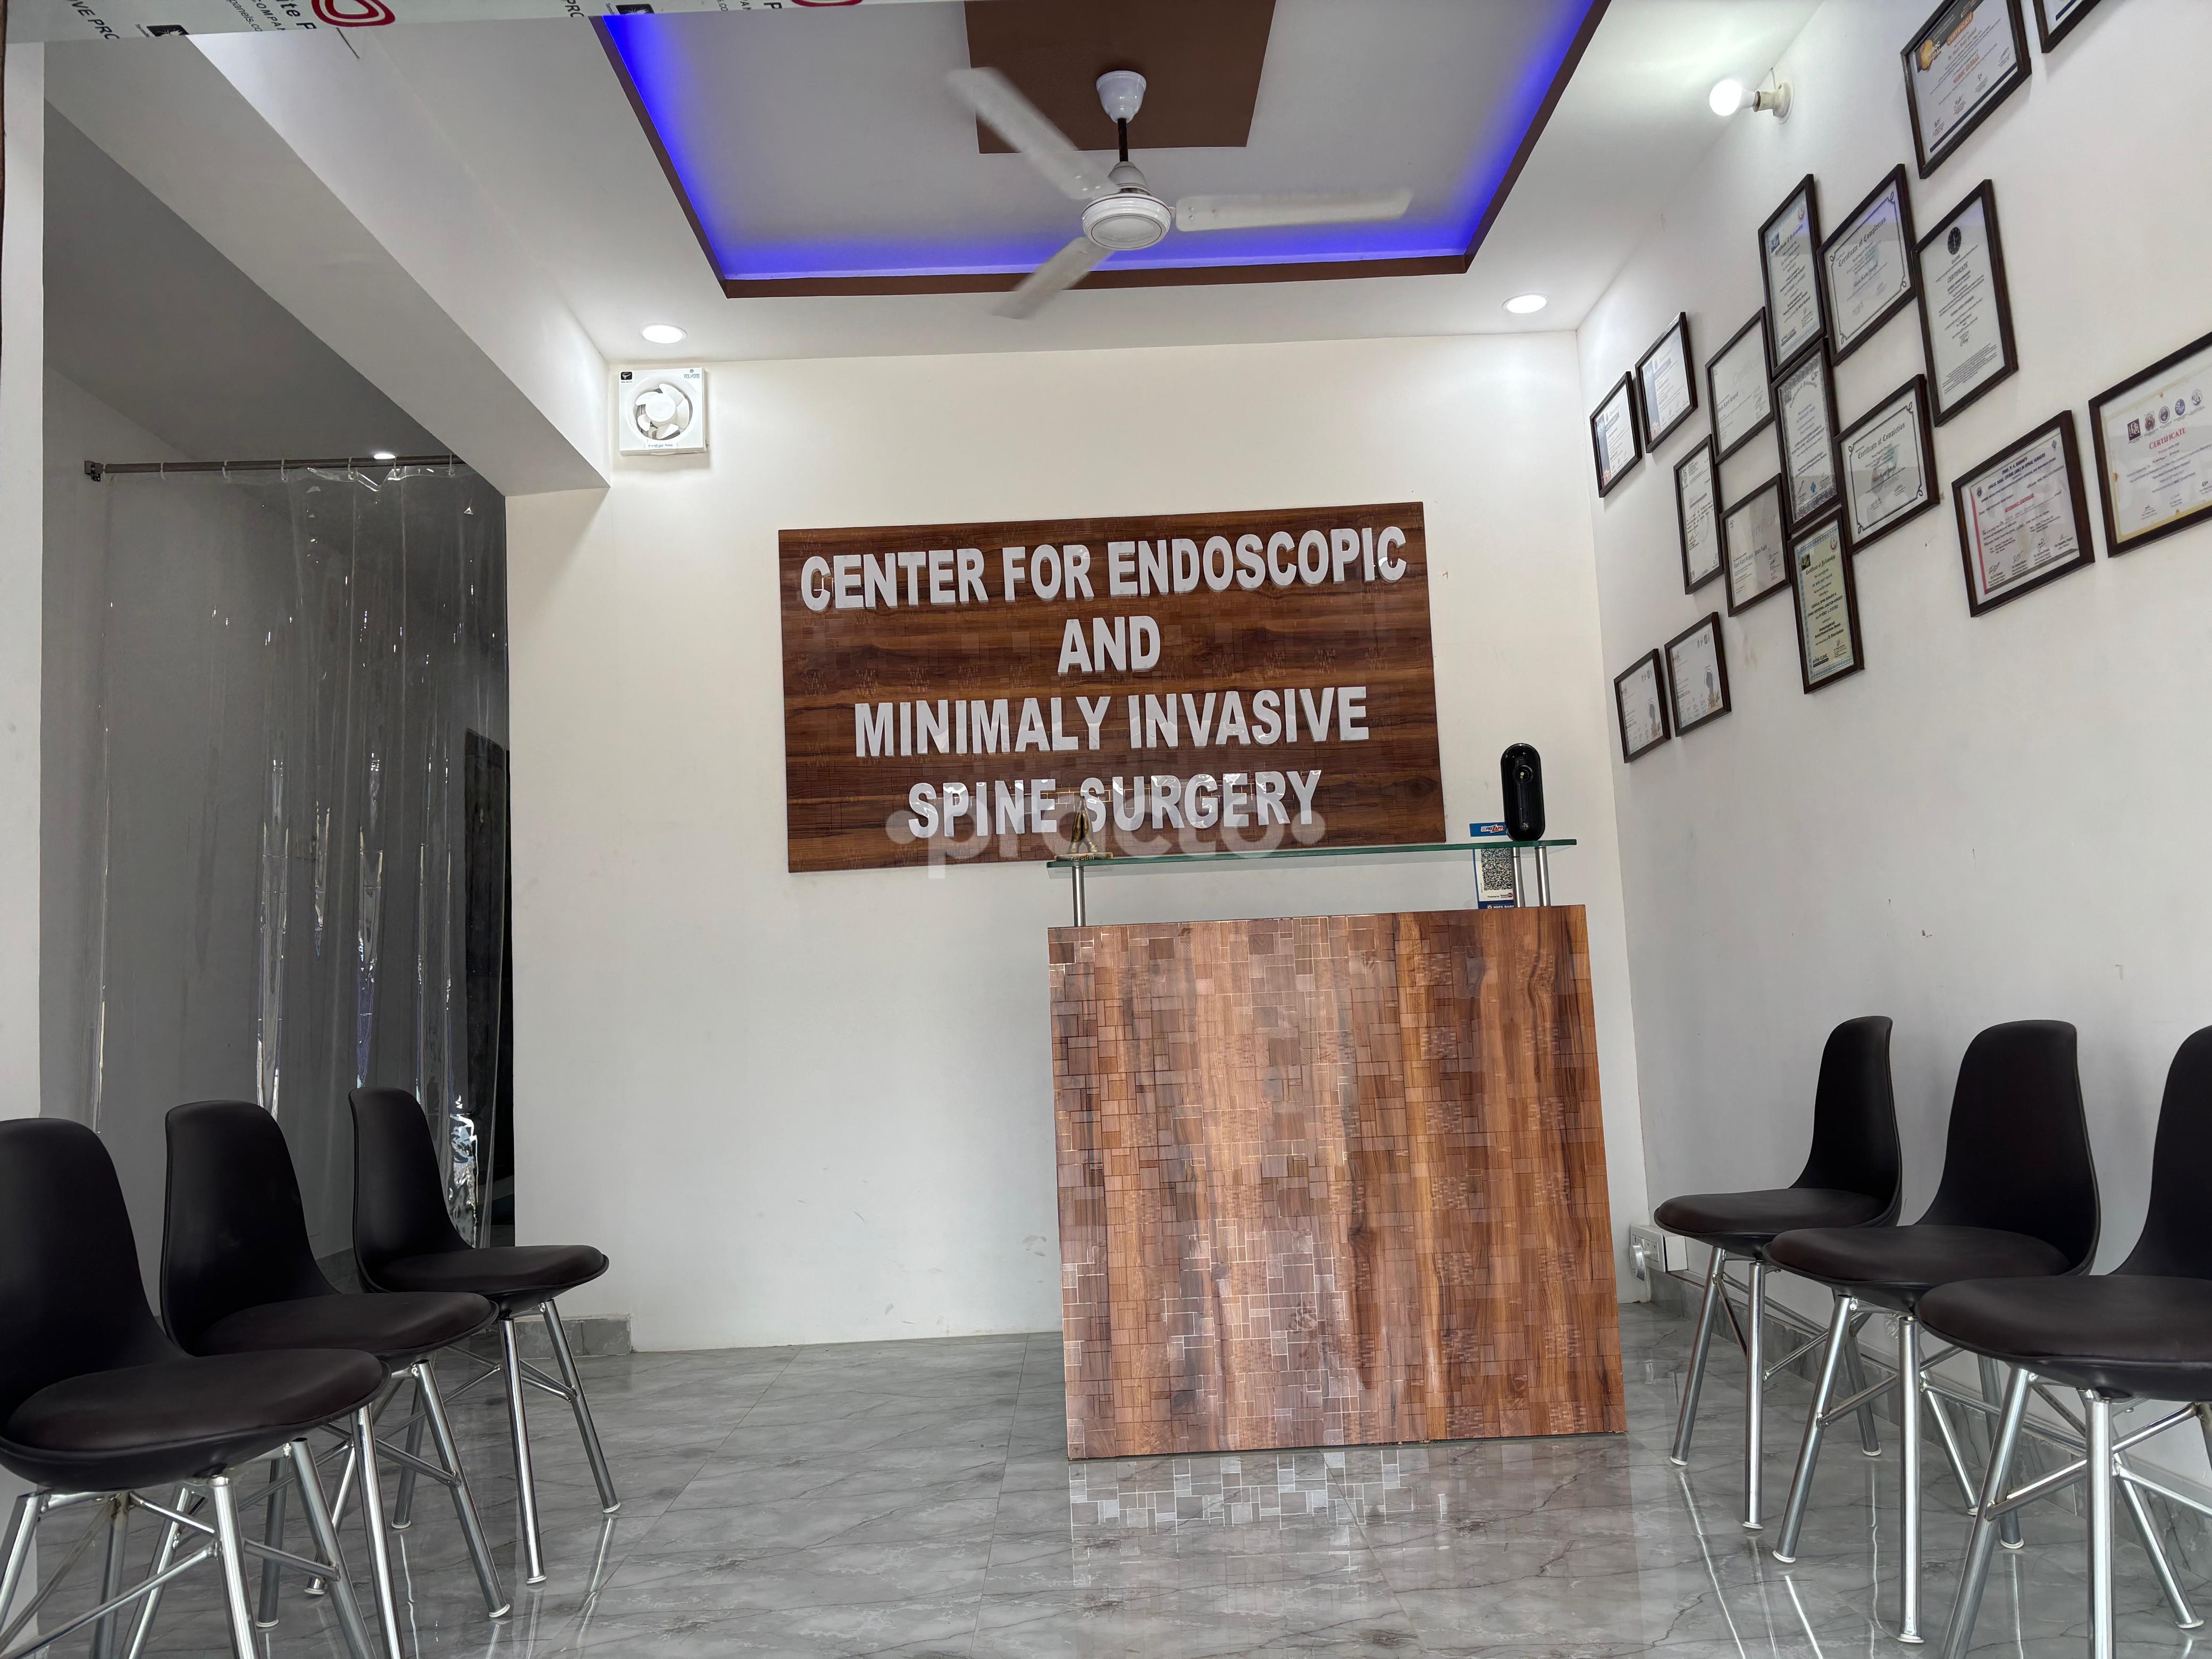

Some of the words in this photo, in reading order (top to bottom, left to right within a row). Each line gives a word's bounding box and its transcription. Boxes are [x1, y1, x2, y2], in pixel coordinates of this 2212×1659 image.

[69, 0, 96, 16] VE
[252, 0, 286, 30] OMPA
[2149, 428, 2186, 449] CERTIFICATE
[801, 548, 989, 613] CENTER
[1002, 544, 1094, 601] FOR
[1108, 526, 1407, 597] ENDOSCOPIC
[1058, 615, 1161, 676] AND
[854, 696, 1111, 758] MINIMALY
[1128, 686, 1370, 749] INVASIVE
[908, 778, 1058, 838] SPINE
[1080, 769, 1322, 833] SURGERY
